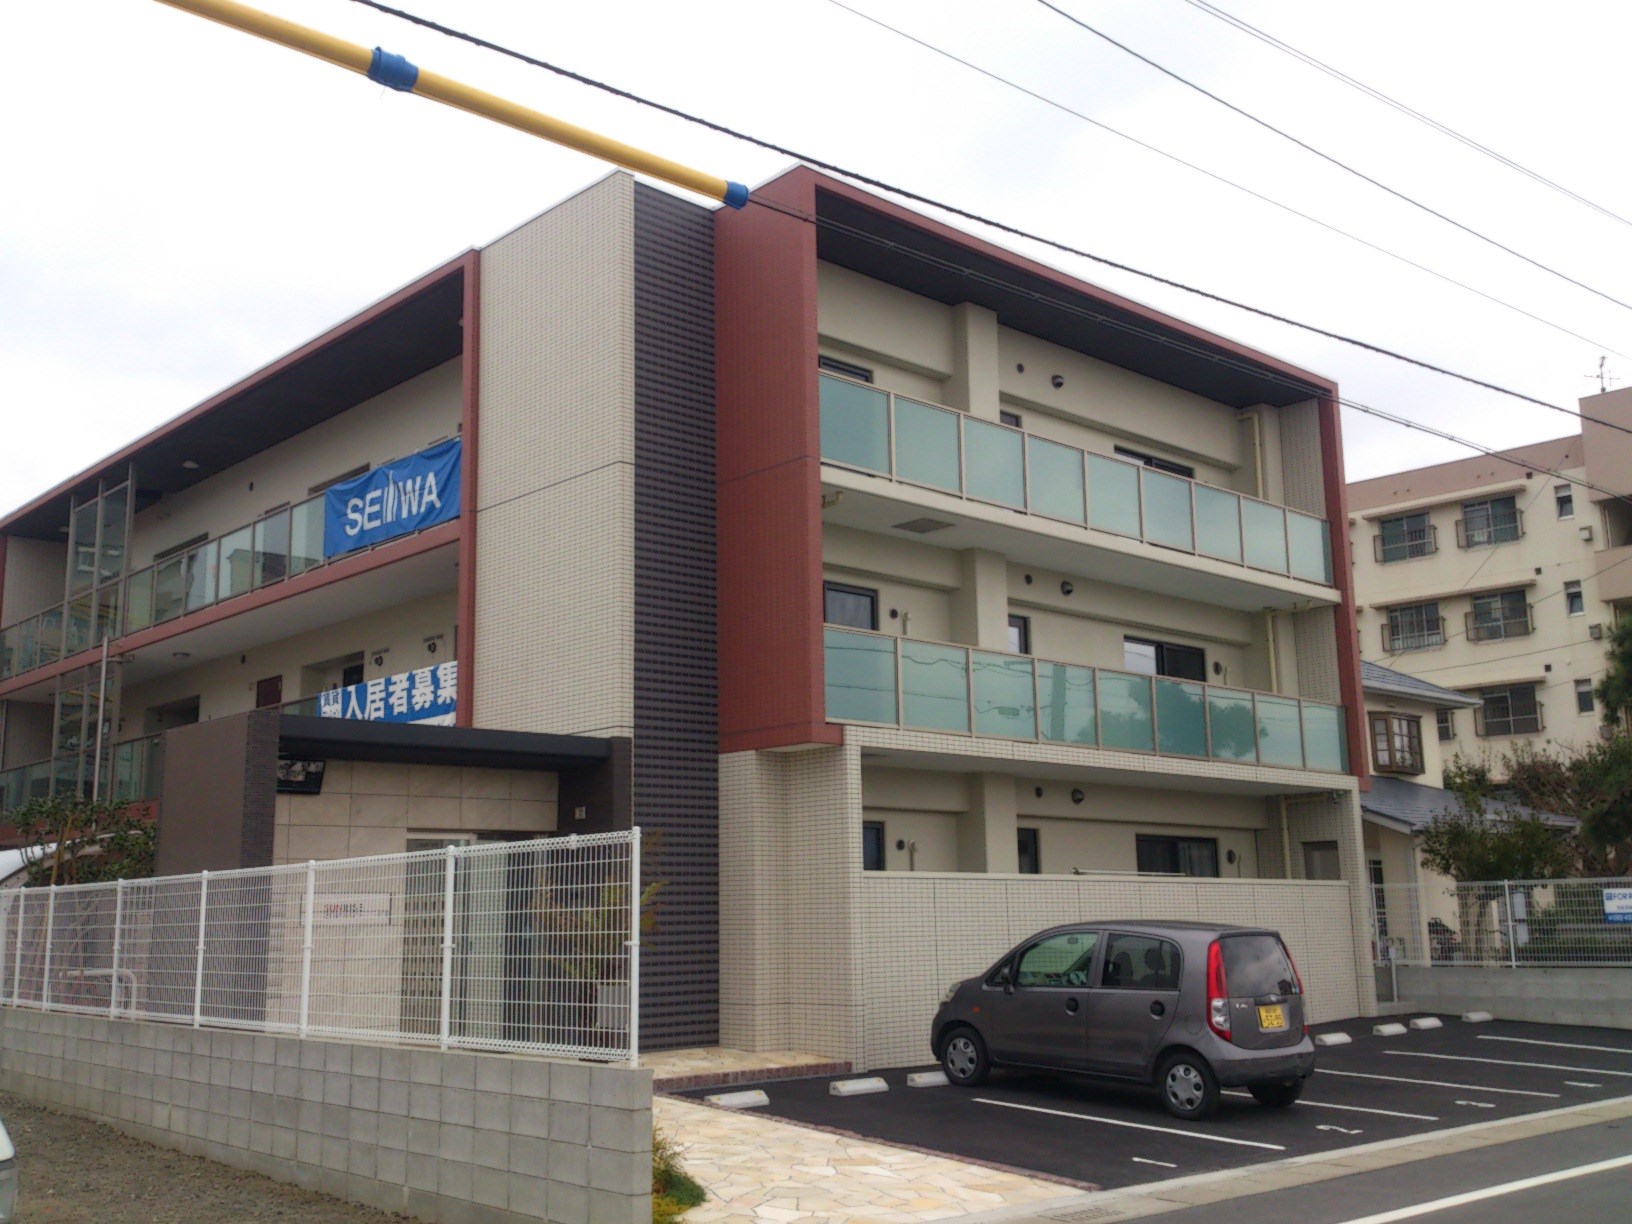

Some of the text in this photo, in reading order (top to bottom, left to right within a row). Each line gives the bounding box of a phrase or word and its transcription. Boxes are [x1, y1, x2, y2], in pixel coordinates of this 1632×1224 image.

[345, 660, 458, 721] 入居者募集
[1612, 892, 1628, 901] FOR
